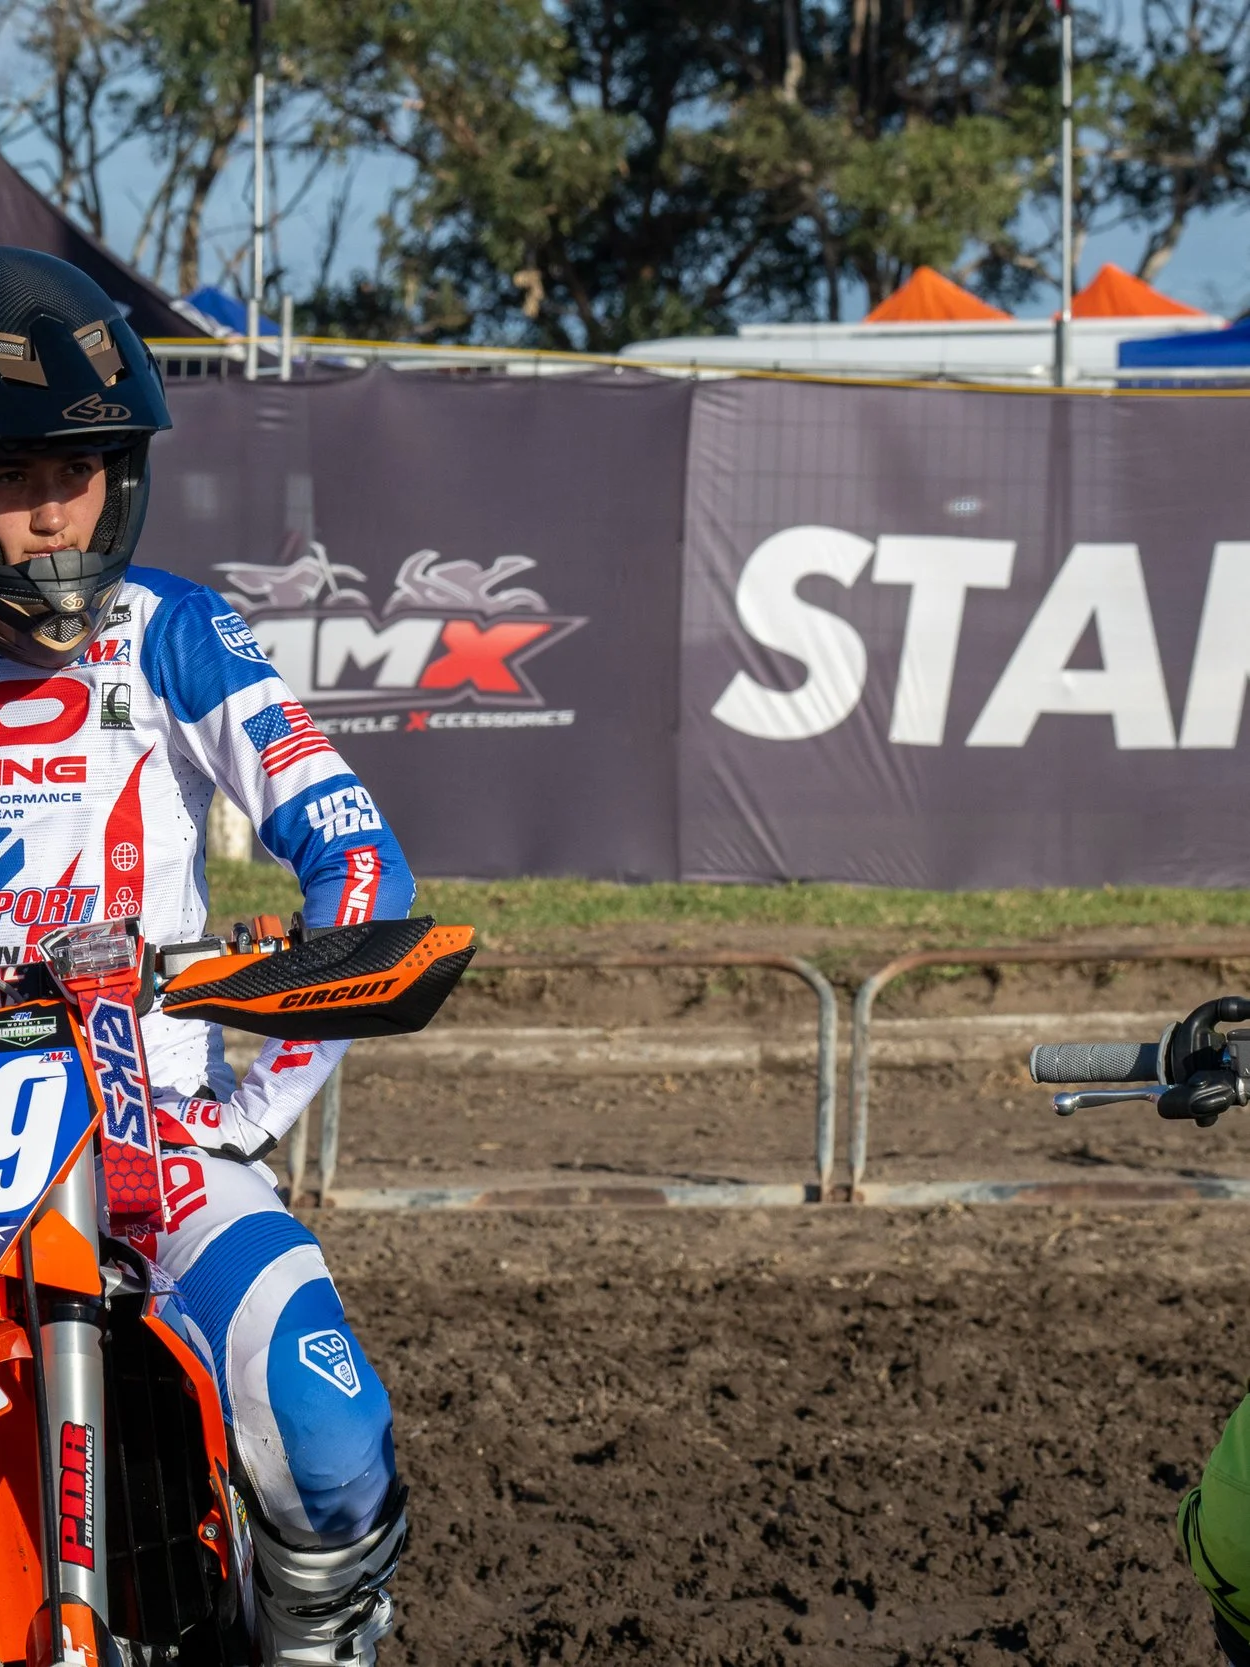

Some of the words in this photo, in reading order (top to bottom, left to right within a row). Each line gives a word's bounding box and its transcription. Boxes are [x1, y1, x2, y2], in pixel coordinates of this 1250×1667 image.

[305, 785, 382, 843] 469
[278, 977, 400, 1010] CIRCUIT
[11, 1012, 32, 1021] FIM
[39, 1051, 72, 1063] AMA
[59, 1420, 95, 1573] PDR
